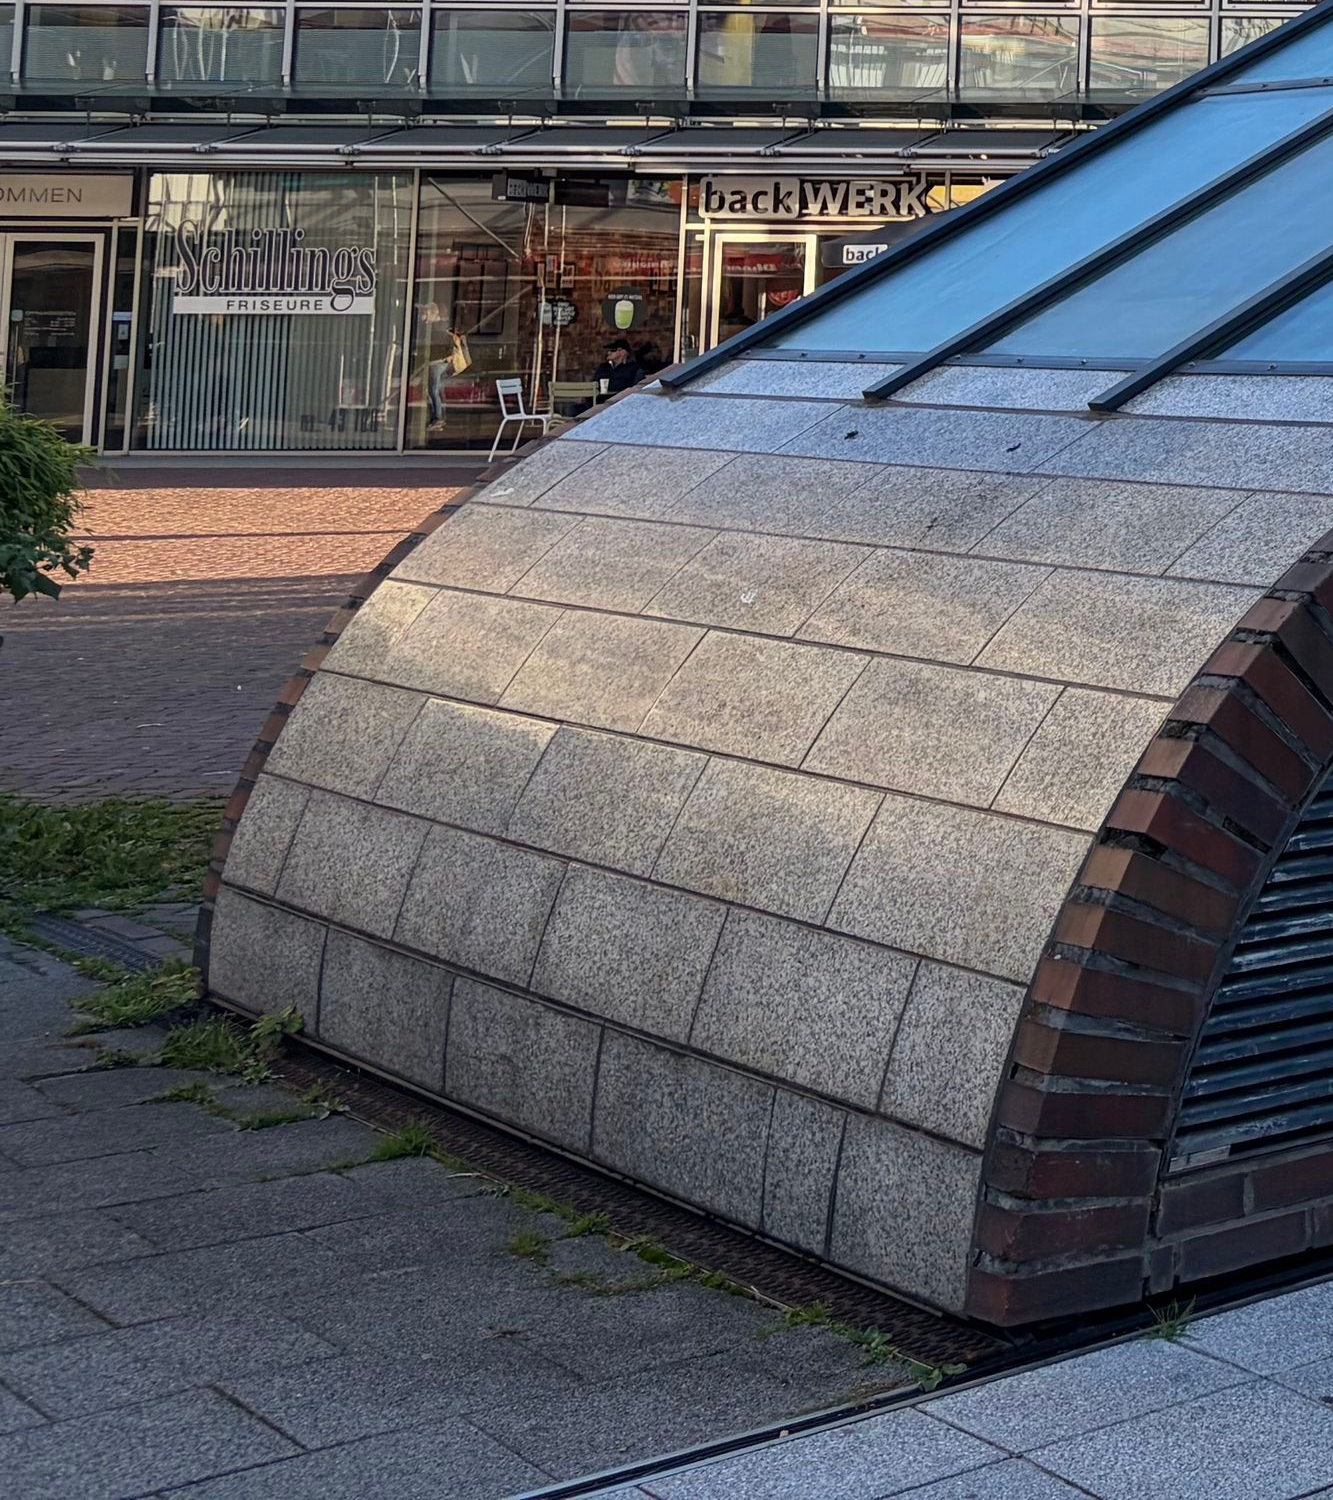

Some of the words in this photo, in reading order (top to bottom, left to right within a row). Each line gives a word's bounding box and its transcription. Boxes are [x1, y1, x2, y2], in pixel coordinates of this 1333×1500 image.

[0, 187, 83, 203] MMEN
[175, 219, 377, 312] Schillings
[226, 299, 323, 311] FRISEURE
